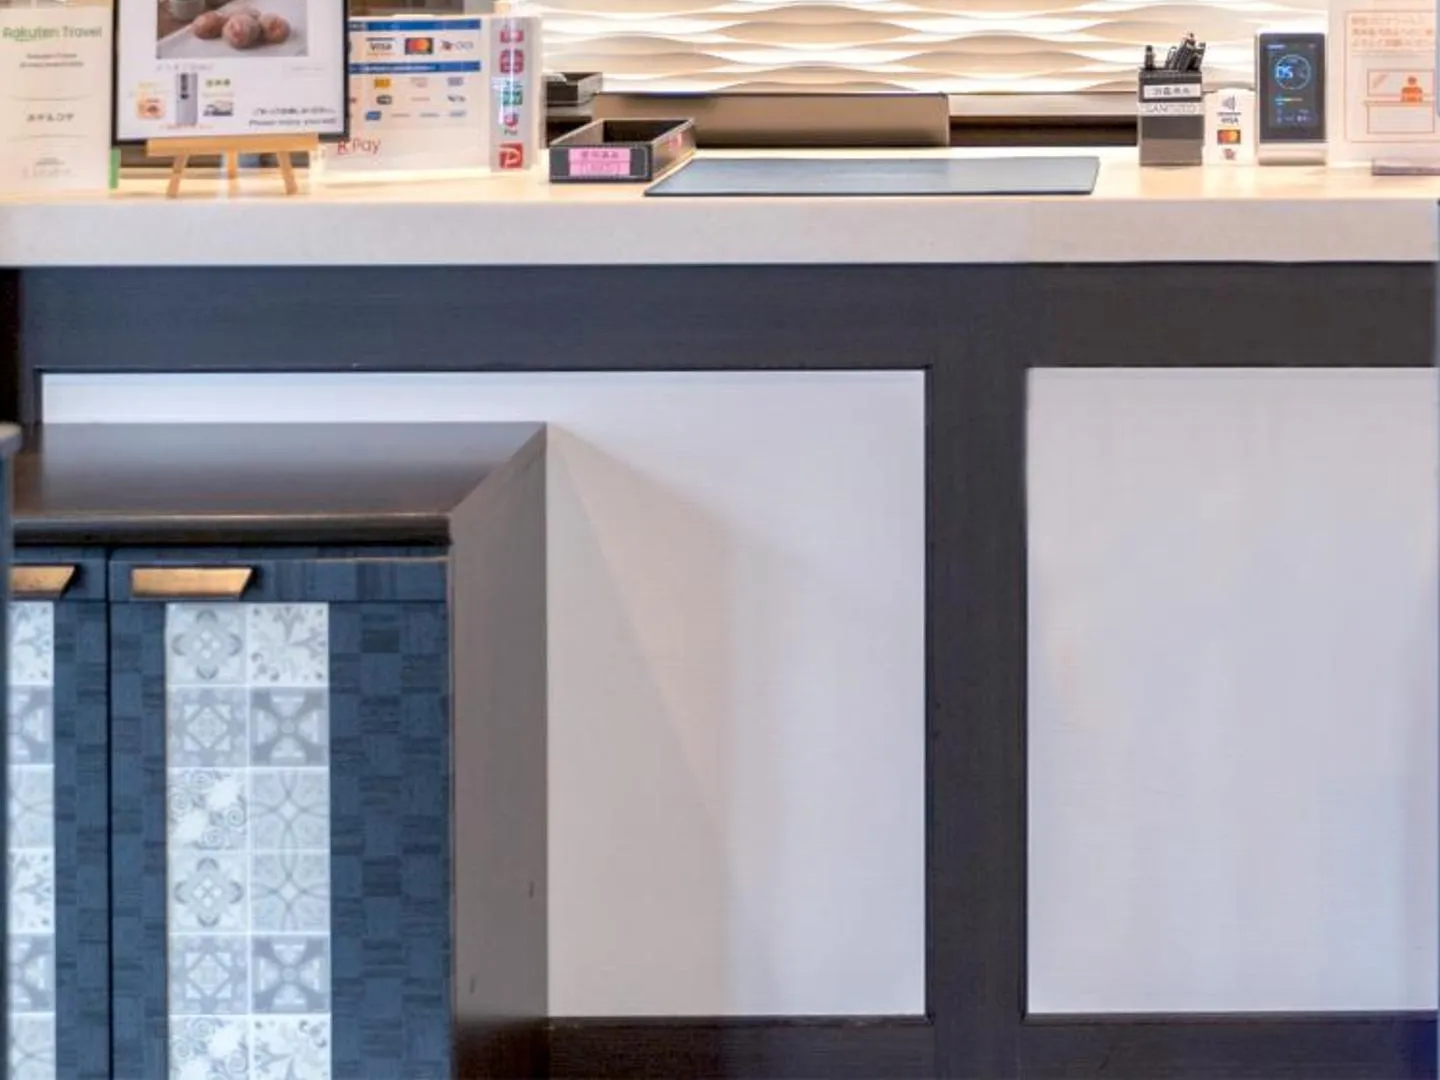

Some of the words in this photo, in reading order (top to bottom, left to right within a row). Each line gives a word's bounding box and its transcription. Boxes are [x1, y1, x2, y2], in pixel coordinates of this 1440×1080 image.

[2, 26, 61, 40] Rakuten
[62, 25, 103, 39] Travel
[352, 137, 382, 154] Pay
